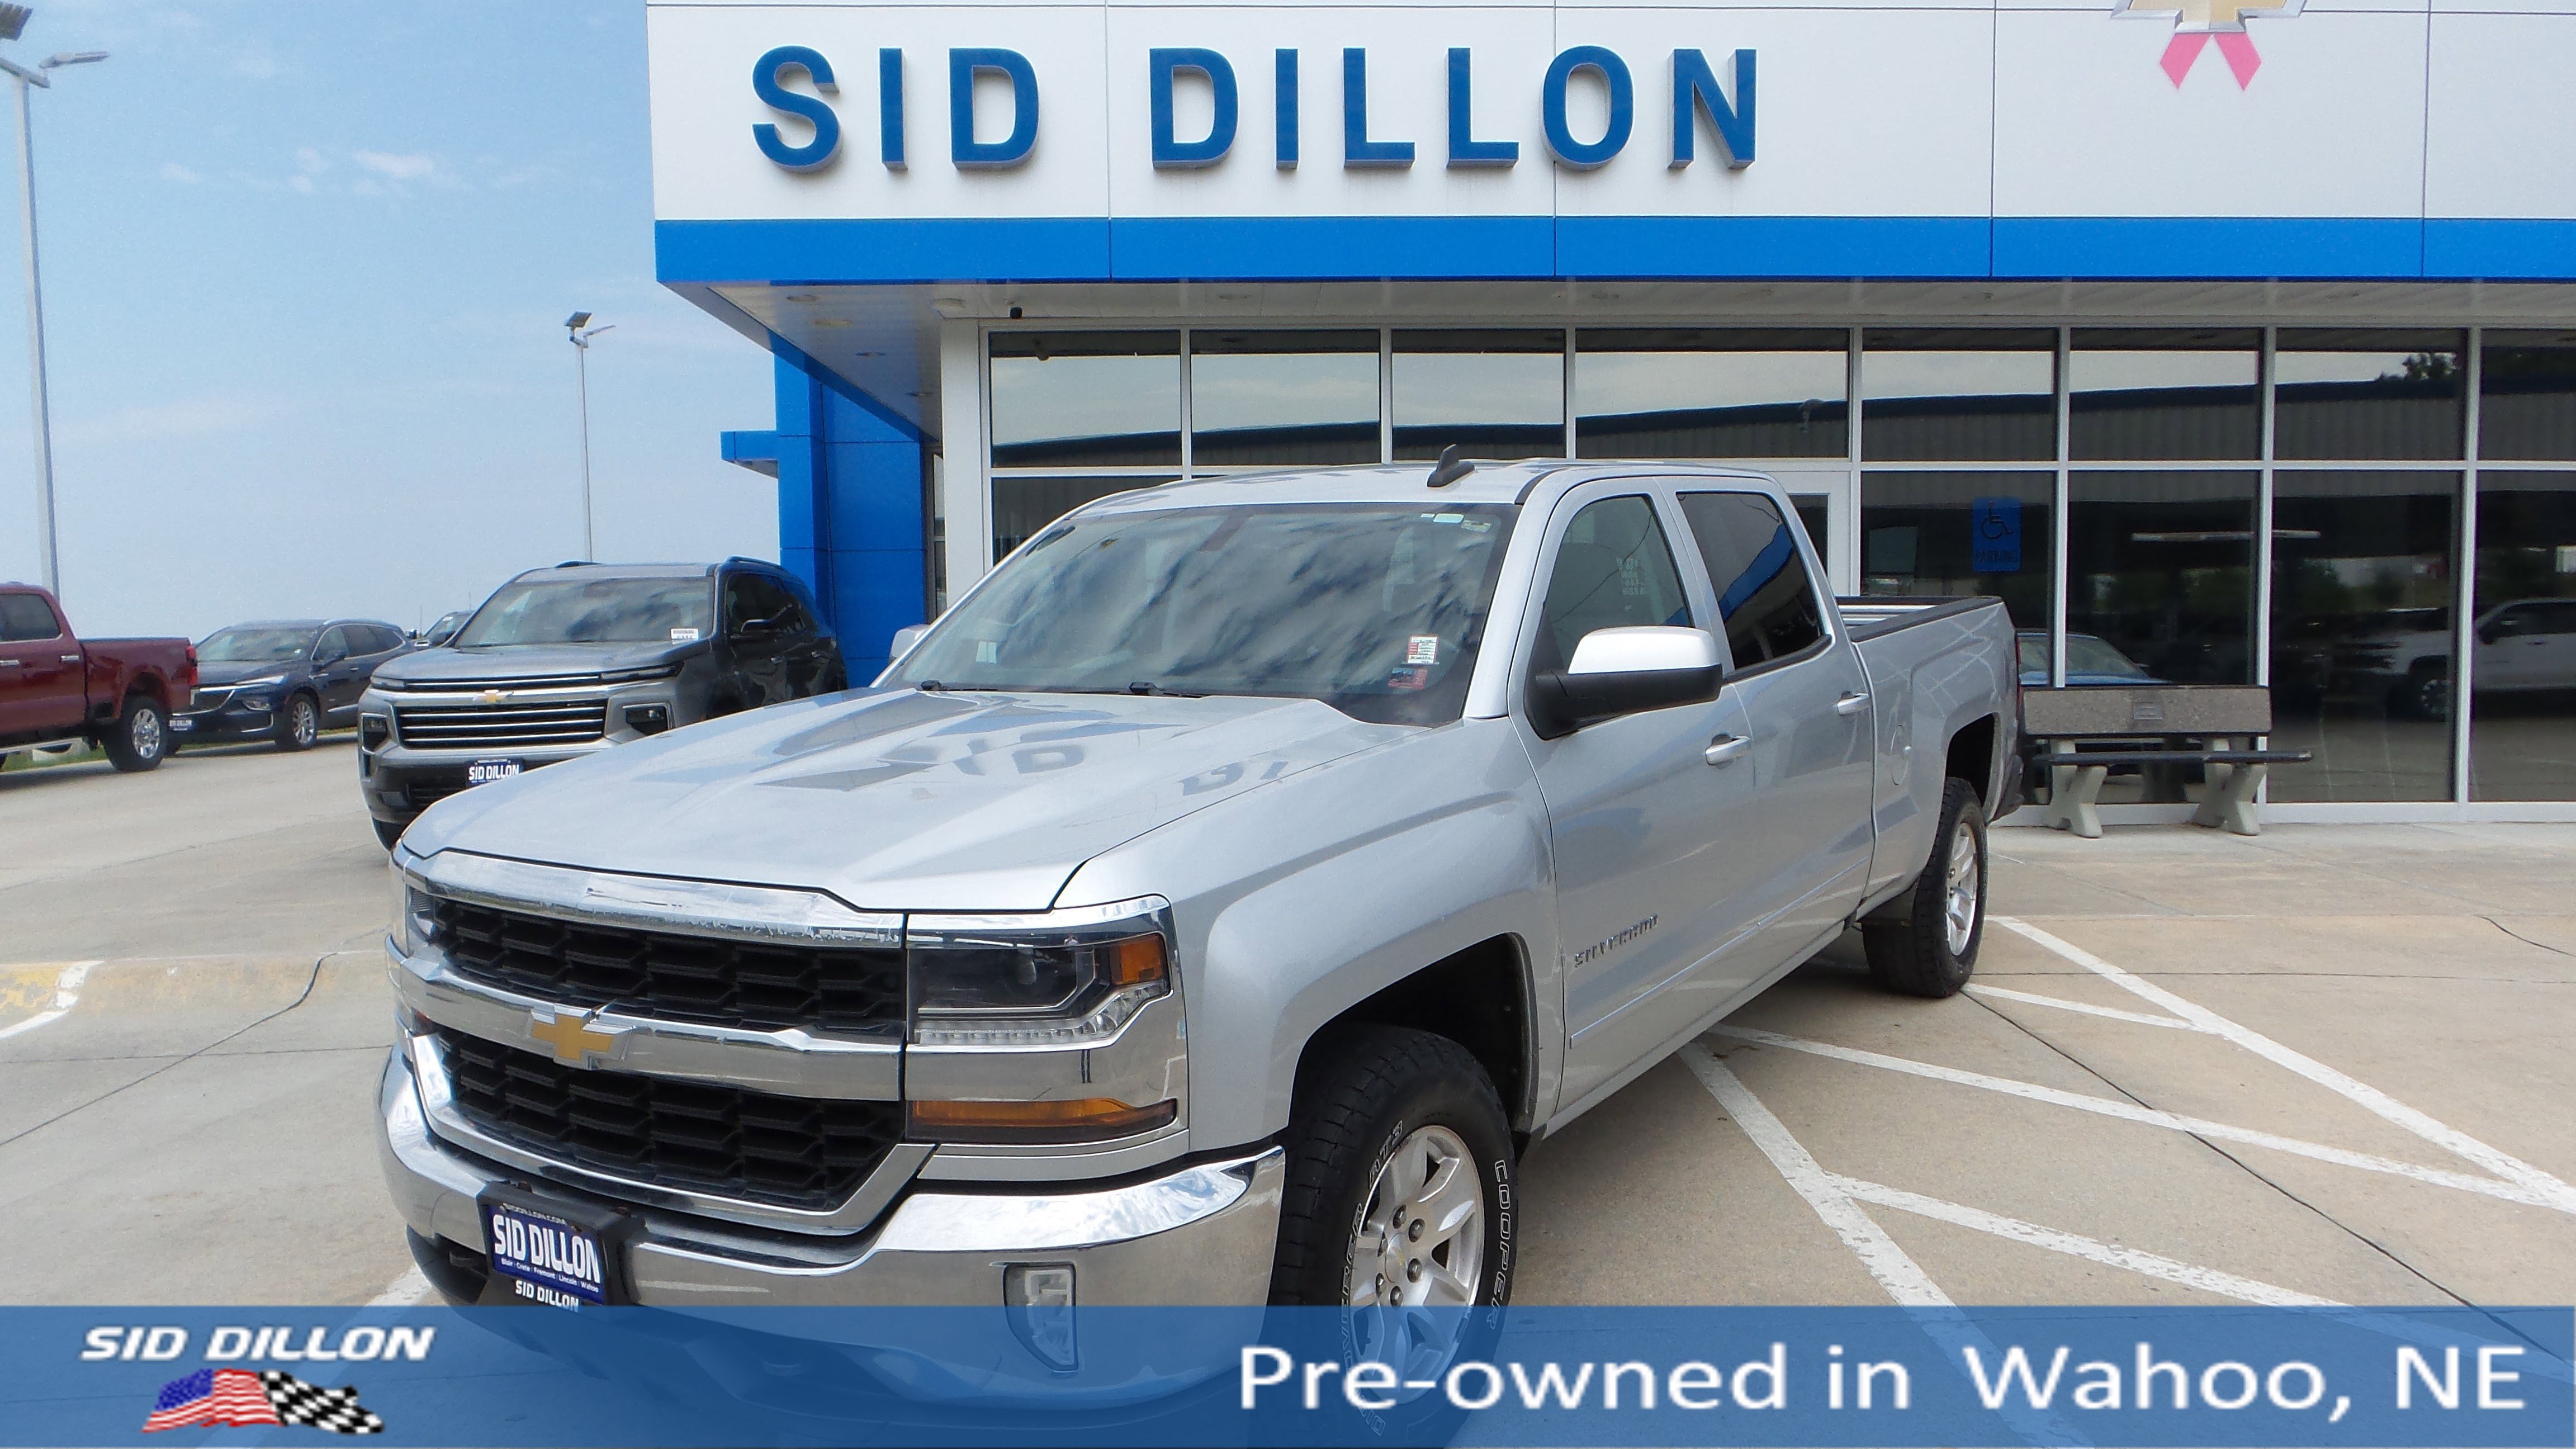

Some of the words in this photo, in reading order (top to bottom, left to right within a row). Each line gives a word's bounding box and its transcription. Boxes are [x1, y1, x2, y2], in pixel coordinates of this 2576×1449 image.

[751, 45, 1040, 171] SID
[1149, 45, 1758, 171] DILLON
[468, 766, 485, 780] SID
[486, 764, 519, 780] DILLON
[493, 1214, 526, 1261] SID
[528, 1223, 601, 1284] DILLON
[1486, 1159, 1511, 1330] COOPER
[515, 1280, 534, 1299] SID
[537, 1286, 579, 1313] DILLON
